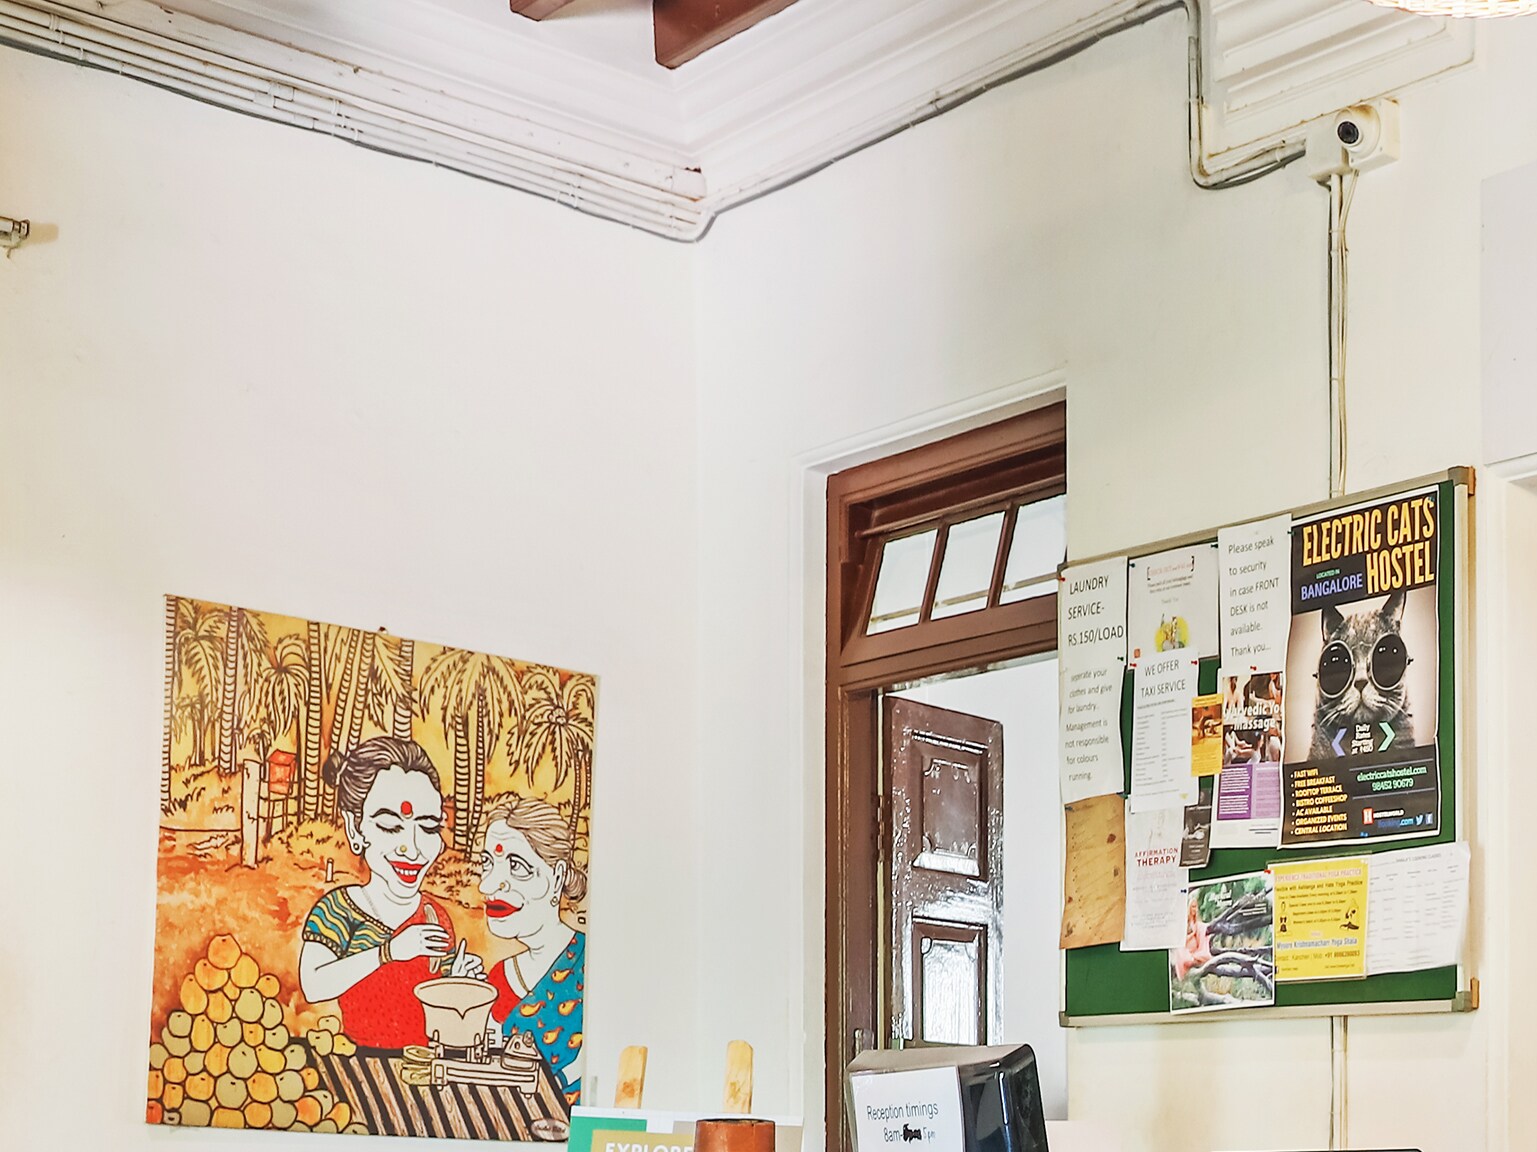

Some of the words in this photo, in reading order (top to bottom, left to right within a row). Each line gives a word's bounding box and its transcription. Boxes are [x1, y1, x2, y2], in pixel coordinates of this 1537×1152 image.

[1302, 507, 1382, 567] ELECTRIC
[1387, 496, 1435, 546] CATS
[1228, 542, 1253, 555] Please
[1254, 536, 1275, 551] speak
[1229, 566, 1237, 576] to
[1239, 560, 1267, 576] security
[1366, 540, 1435, 595] HOSTEL
[1069, 575, 1109, 595] LAUNDRY
[1230, 587, 1237, 597] in
[1238, 583, 1254, 595] case
[1255, 577, 1280, 592] FRONT
[1301, 573, 1363, 600] BANGALORE
[1230, 603, 1248, 617] DESK
[1250, 602, 1255, 613] is
[1256, 600, 1269, 611] not
[1231, 645, 1251, 658] Thank
[1144, 664, 1156, 677] WE
[1157, 659, 1180, 673] OFFER
[1088, 684, 1100, 694] and
[1099, 683, 1113, 695] give
[1141, 684, 1156, 698] TAXI
[1157, 679, 1186, 695] SERVICE
[1068, 705, 1077, 715] for
[1066, 720, 1102, 732] Management
[1065, 738, 1075, 748] not
[1075, 735, 1109, 747] responsible
[1066, 755, 1076, 765] for
[1077, 753, 1098, 764] colours
[1135, 847, 1179, 858] AFFIRMATION
[1137, 855, 1177, 867] THERAPY
[867, 1105, 904, 1122] Reception
[905, 1101, 938, 1119] timings
